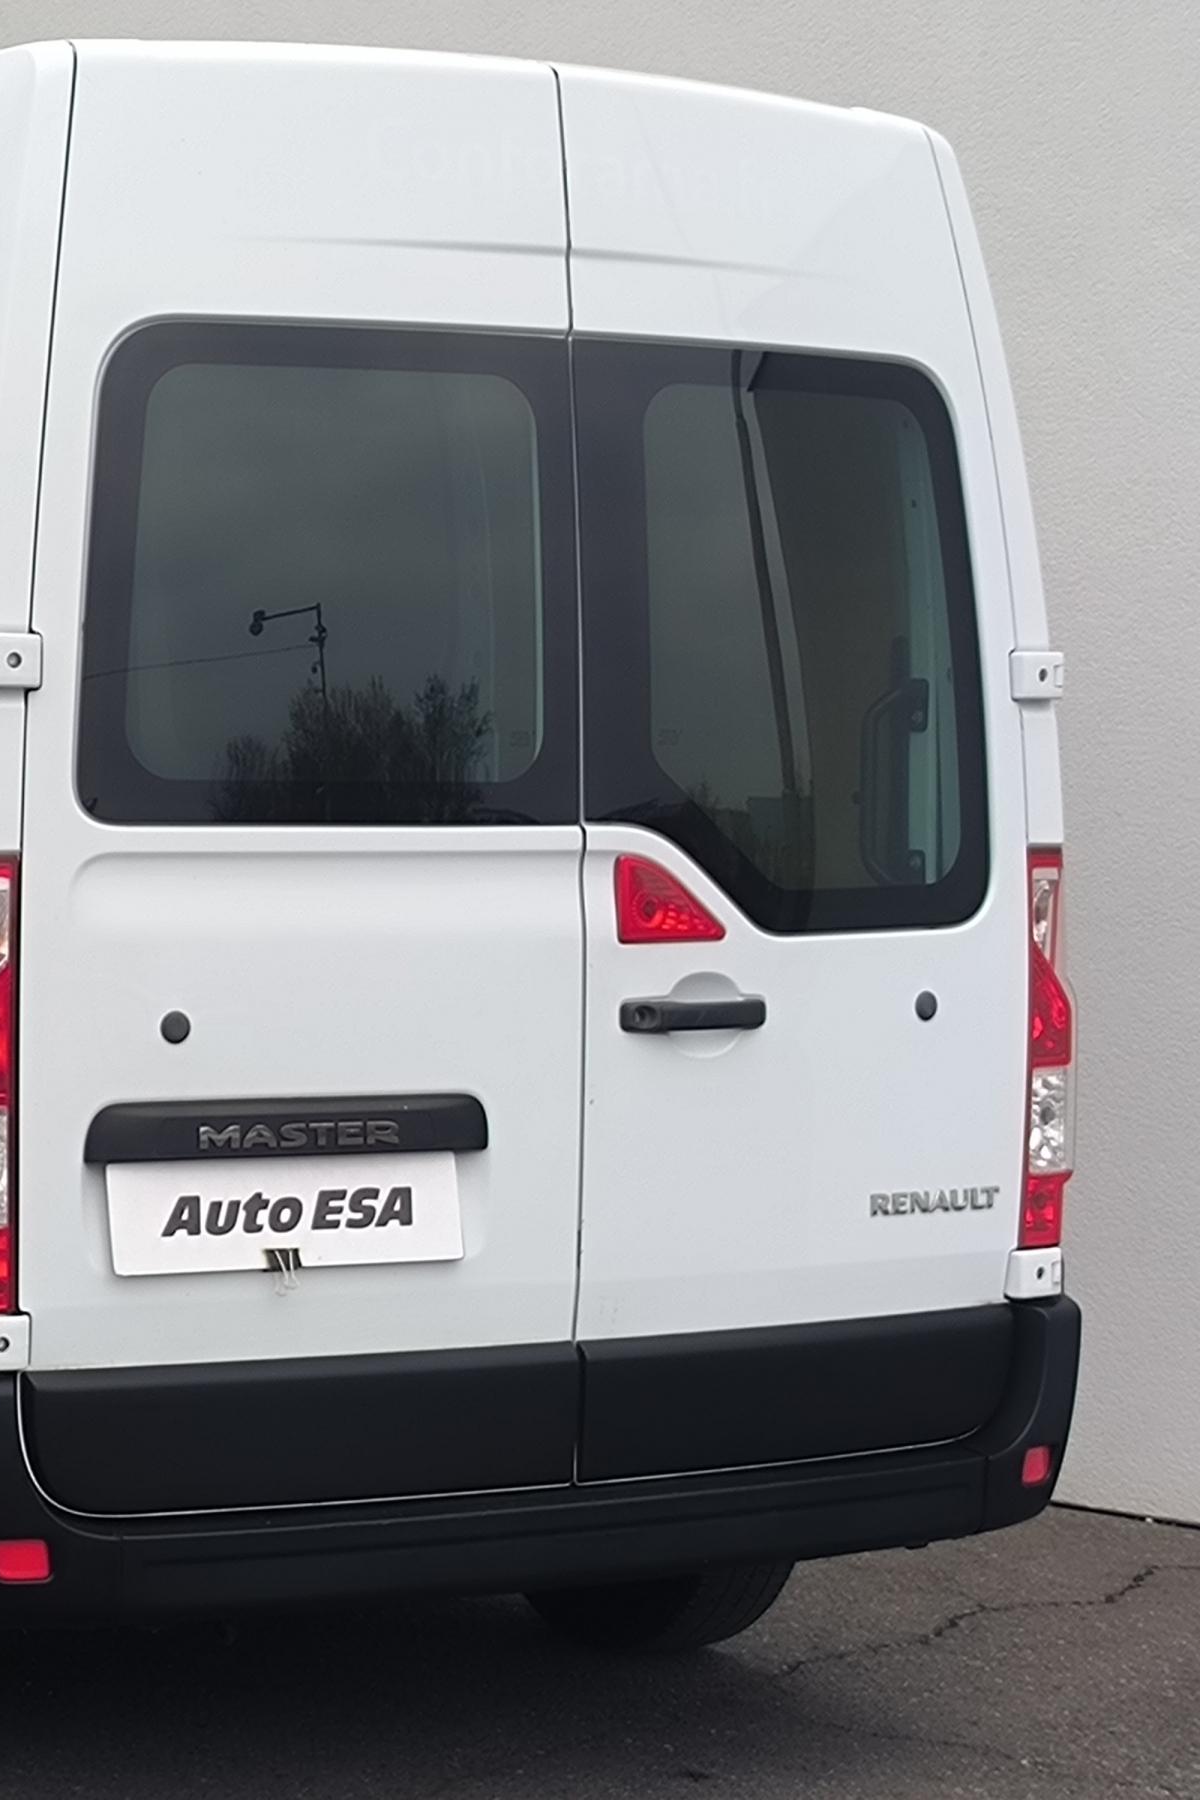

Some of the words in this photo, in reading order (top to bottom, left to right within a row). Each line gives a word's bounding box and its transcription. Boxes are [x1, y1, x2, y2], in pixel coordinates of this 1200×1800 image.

[199, 1120, 400, 1150] MASTER
[161, 1191, 304, 1238] Auto
[311, 1186, 414, 1231] ESA
[869, 1186, 1000, 1218] RENAULT
